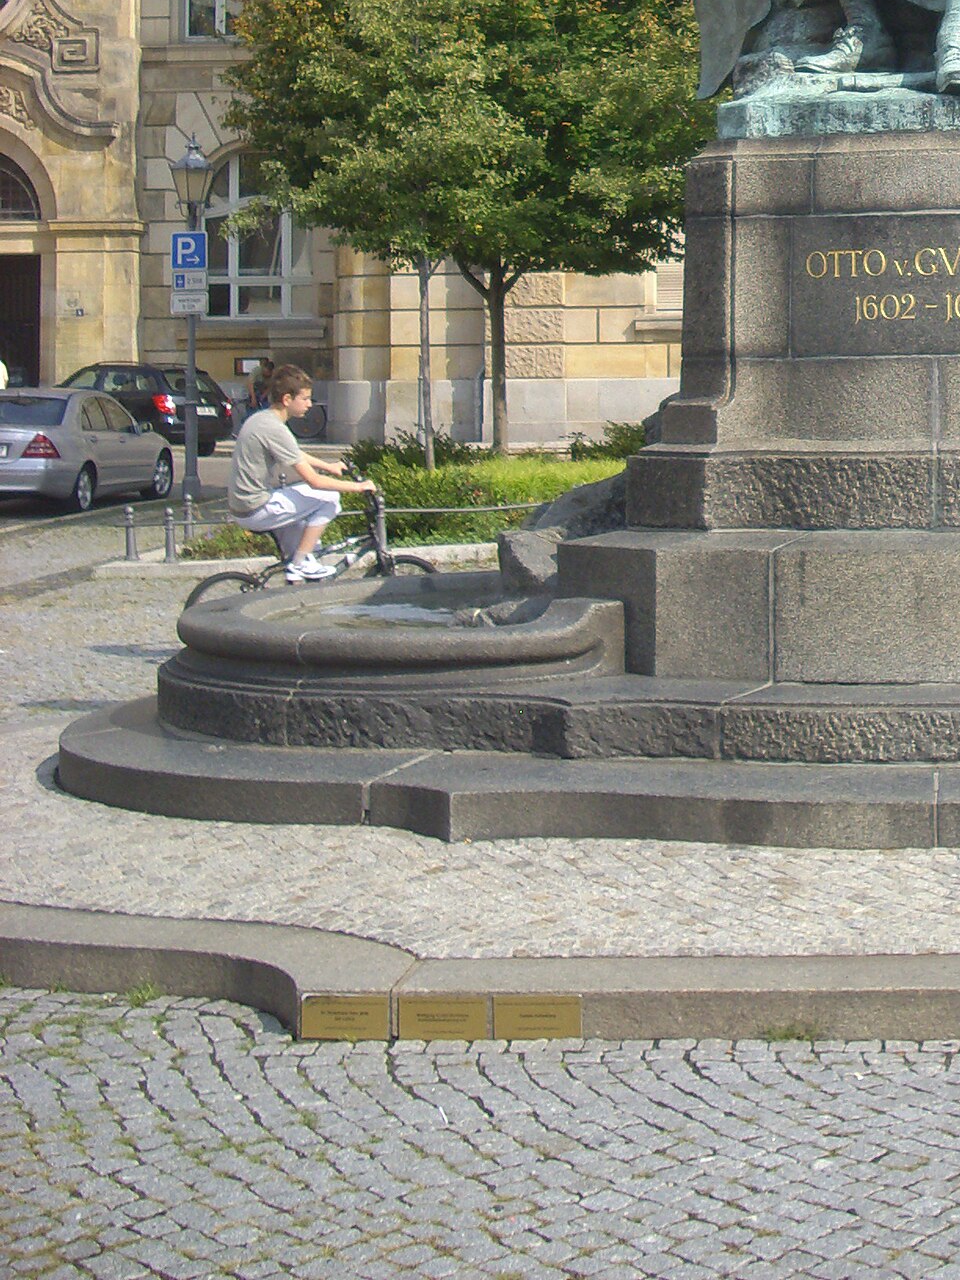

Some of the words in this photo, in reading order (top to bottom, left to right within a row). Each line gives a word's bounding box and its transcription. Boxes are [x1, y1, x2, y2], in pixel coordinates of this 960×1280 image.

[177, 238, 195, 265] P
[805, 249, 886, 278] OTTO
[855, 293, 916, 324] 1602
